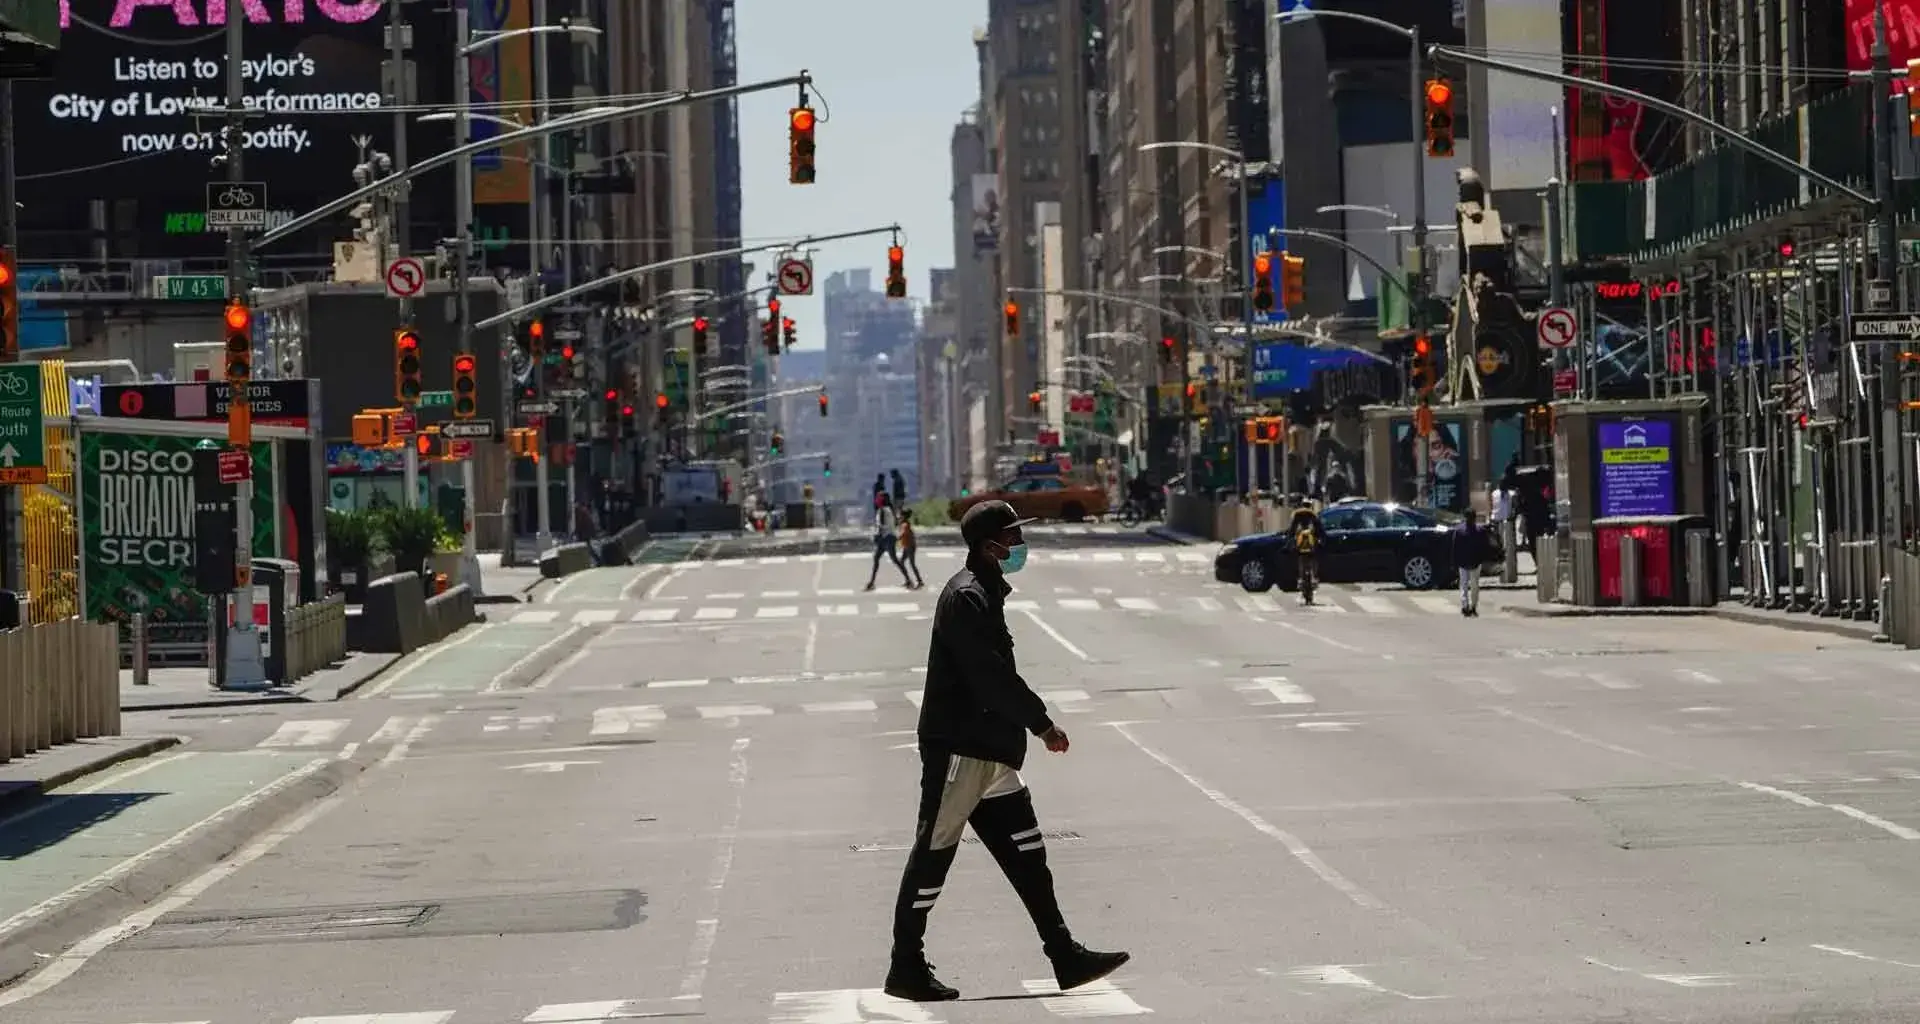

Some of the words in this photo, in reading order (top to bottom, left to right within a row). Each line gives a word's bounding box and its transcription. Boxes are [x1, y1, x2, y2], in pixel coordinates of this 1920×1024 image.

[114, 56, 187, 81] Listen
[193, 57, 219, 79] to
[223, 52, 315, 83] aylor's
[49, 93, 105, 123] City
[110, 92, 139, 117] of
[225, 88, 381, 112] erformance
[122, 133, 176, 152] now
[211, 211, 231, 222] BIKE
[237, 211, 262, 222] LANE
[171, 279, 184, 296] W
[191, 279, 208, 297] 45
[1862, 322, 1887, 334] ONE
[216, 386, 271, 399] VITOR
[1, 407, 32, 418] Route
[216, 401, 281, 413] SICES
[100, 449, 194, 473] DISCO
[100, 473, 196, 539] BROADW
[100, 538, 197, 567] SECR
